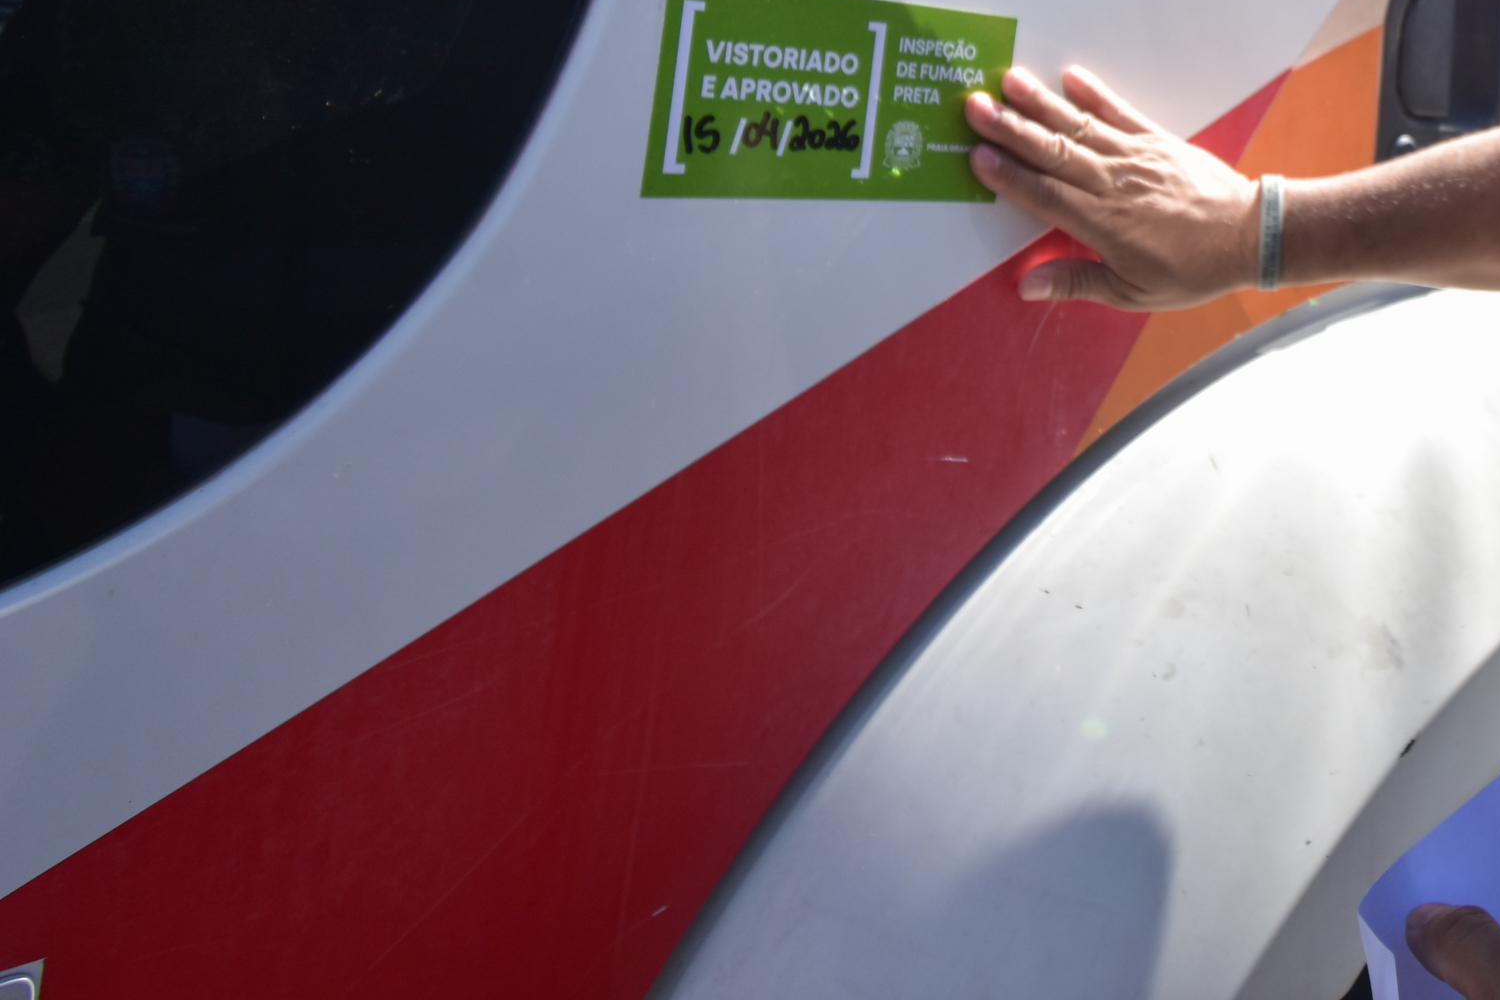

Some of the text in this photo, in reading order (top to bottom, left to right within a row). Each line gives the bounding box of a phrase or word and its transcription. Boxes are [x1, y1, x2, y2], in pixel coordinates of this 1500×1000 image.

[706, 39, 859, 76] VISTORIADO
[899, 36, 977, 62] INSPEÇÃO
[896, 60, 985, 88] DE FUMAÇA
[701, 75, 859, 108] E APROVADO
[893, 86, 940, 105] PRETA
[926, 143, 949, 153] PRAIA
